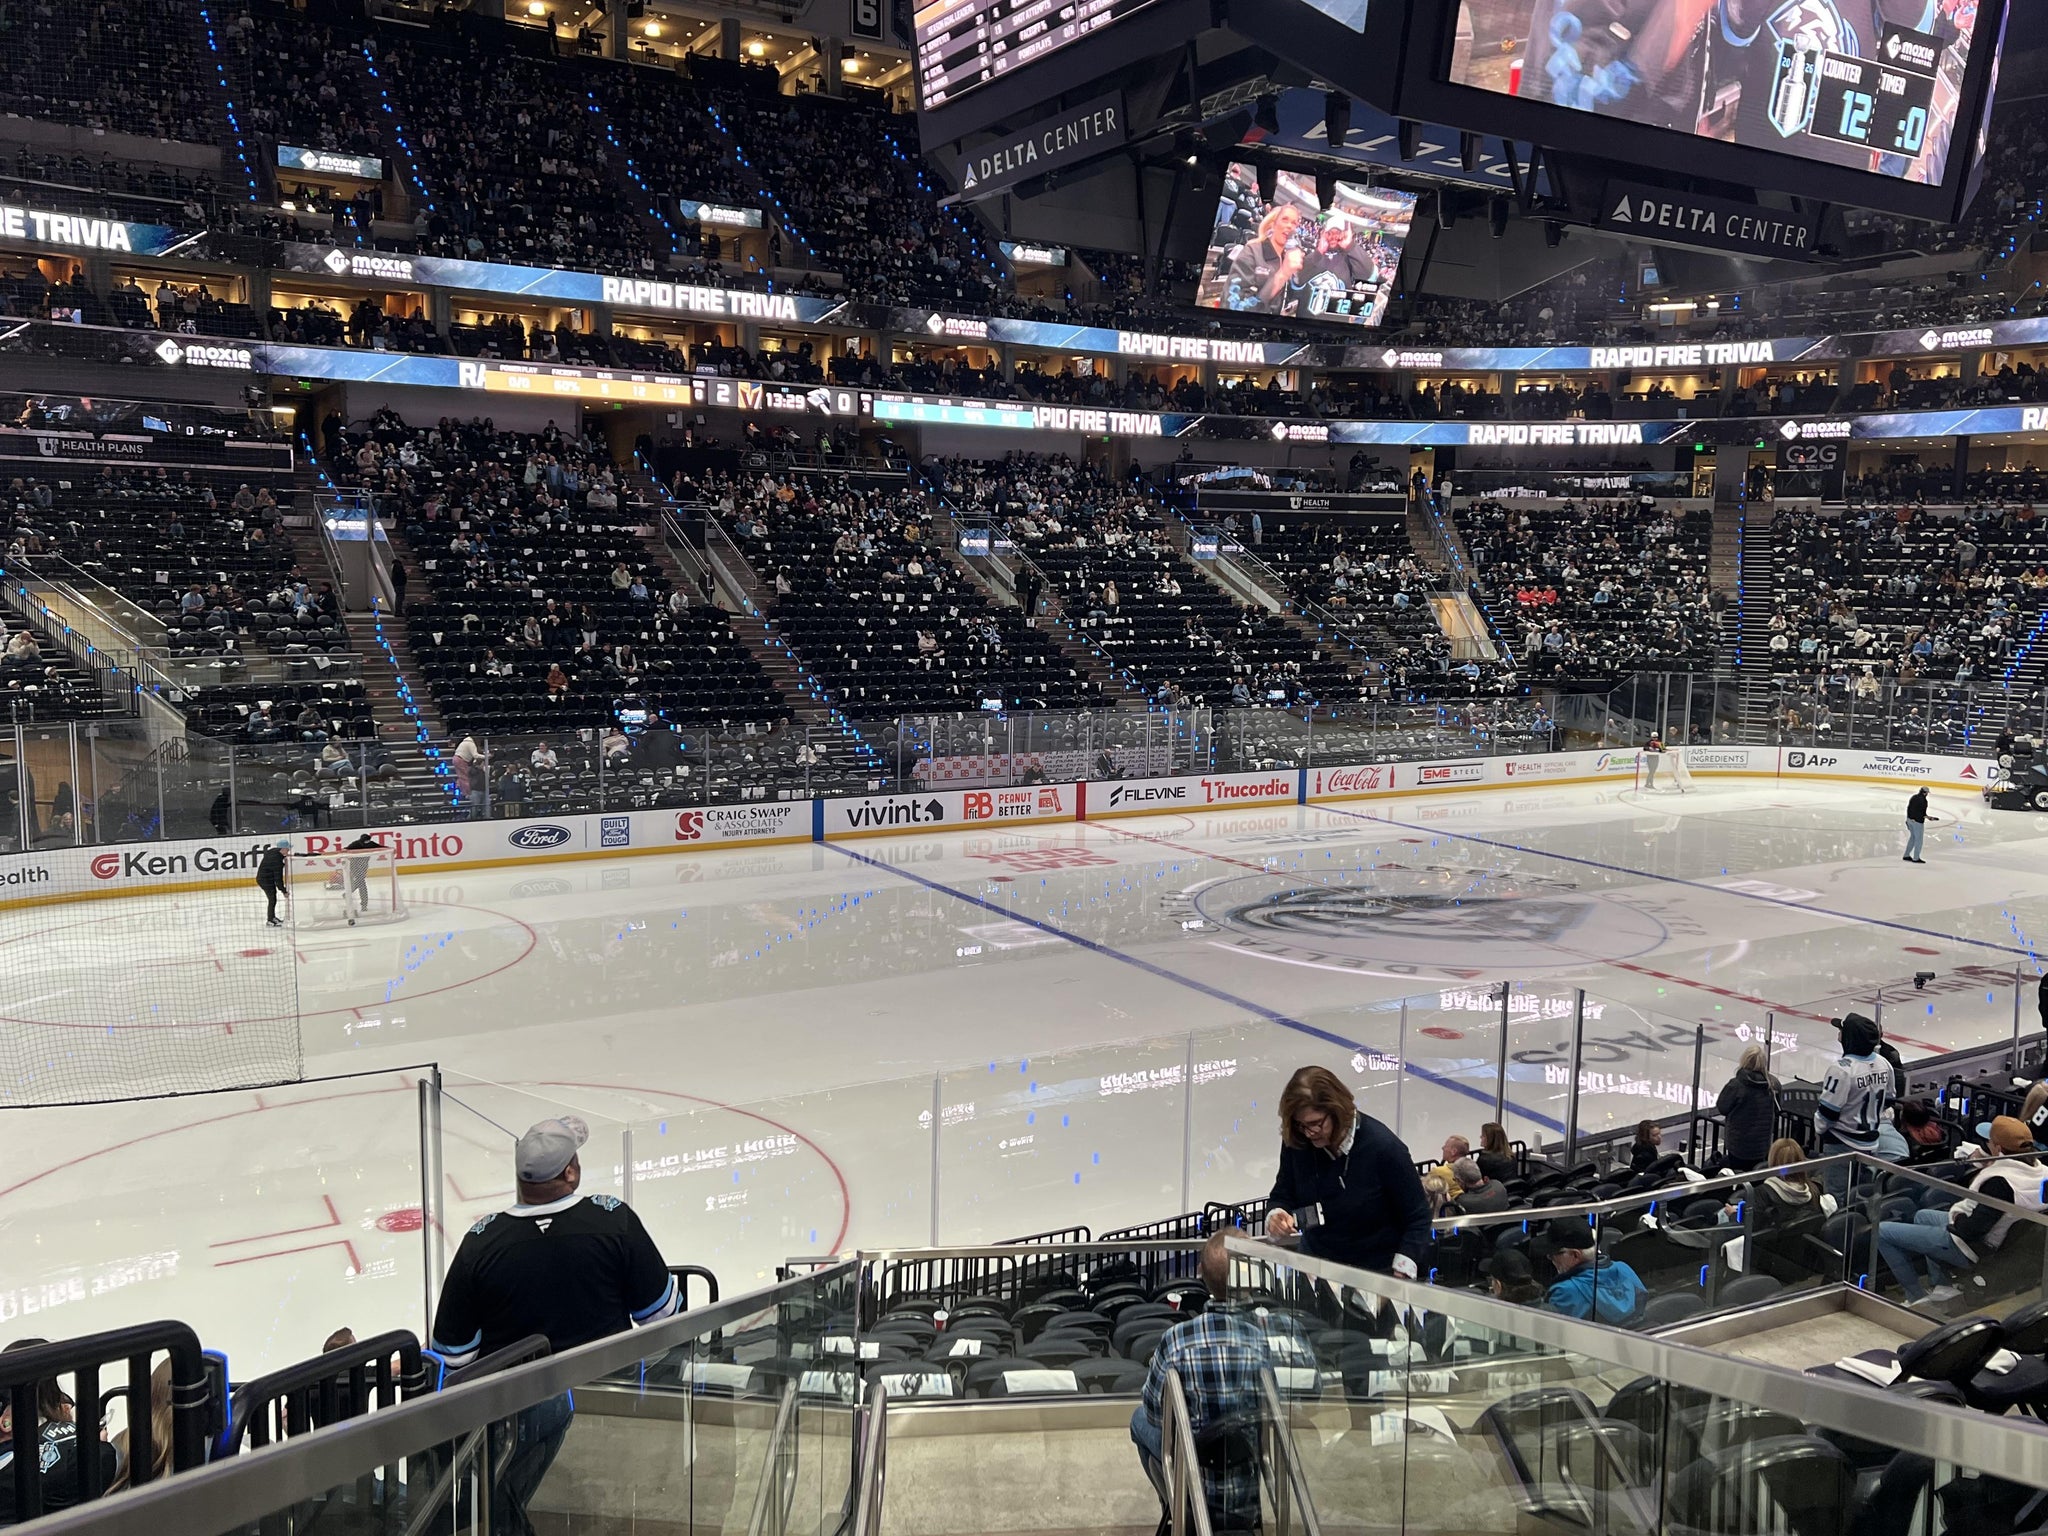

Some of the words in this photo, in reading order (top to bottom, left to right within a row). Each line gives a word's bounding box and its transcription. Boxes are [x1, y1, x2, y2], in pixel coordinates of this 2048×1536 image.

[1902, 41, 1935, 60] moxie
[1823, 58, 1862, 84] COUNTER
[1881, 73, 1906, 95] TIMER
[1839, 90, 1872, 139] 12
[980, 141, 1037, 179] DELTA
[1043, 107, 1117, 155] CENTER
[319, 156, 360, 170] moxie
[711, 207, 745, 219] moxie
[0, 207, 26, 238] E
[28, 211, 132, 251] TRIVIA
[1639, 200, 1716, 234] DELTA
[1725, 215, 1807, 249] CENTER
[352, 254, 412, 272] moxie
[374, 270, 412, 279] CONTROL
[603, 277, 673, 307] RAPID
[675, 285, 725, 312] FIRE
[727, 291, 797, 319] TRIVIA
[1336, 299, 1351, 314] 12
[945, 317, 988, 332] moxie
[1942, 328, 1993, 343] moxie
[186, 345, 251, 362] moxie
[1118, 332, 1169, 356] RAPID
[1171, 335, 1208, 360] FIRE
[1210, 340, 1264, 363] TRIVIA
[1591, 347, 1654, 368] RAPID
[1655, 345, 1702, 366] FIRE
[1705, 341, 1774, 365] TRIVIA
[209, 360, 251, 369] CONTROL
[1400, 352, 1443, 362] moxie
[716, 383, 730, 403] 2
[765, 392, 805, 409] 13:29
[838, 393, 850, 412] 0
[862, 401, 870, 413] 3
[1069, 410, 1105, 431] FIRE
[1108, 413, 1162, 435] TRIVIA
[1288, 424, 1328, 436] moxie
[1801, 421, 1851, 433] moxie
[1468, 425, 1529, 444] RAPID
[1530, 424, 1575, 444] FIRE
[1578, 424, 1643, 444] TRIVIA
[61, 440, 105, 452] HEALTH
[108, 443, 144, 454] PLANS
[1303, 499, 1330, 507] HEALTH
[1517, 762, 1542, 772] HEALTH
[1690, 755, 1745, 764] INGREDIENTS
[1807, 755, 1837, 768] APP
[1423, 768, 1451, 780] SME
[1453, 767, 1481, 776] STEEL
[1863, 763, 1903, 773] AMERICA
[1905, 766, 1932, 774] FIRST
[1124, 786, 1186, 801] FILEVINE
[1214, 778, 1290, 798] Trucordia
[998, 791, 1032, 804] PEANUT
[963, 792, 993, 819] PB
[998, 805, 1032, 817] BETTER
[706, 809, 747, 822] CRAIG
[749, 807, 791, 819] SWAPP
[847, 799, 921, 828] vivint
[968, 807, 978, 820] fit
[604, 820, 627, 830] BUILT
[714, 821, 723, 831] &
[723, 818, 784, 830] ASSOCIATES
[520, 827, 559, 847] Ford
[604, 836, 627, 845] TOUGH
[722, 829, 743, 838] INJURY
[743, 828, 776, 837] ATTORNEYS
[966, 847, 1093, 864] GEEK
[124, 850, 188, 877] Ken
[1008, 856, 1118, 873] SEAT
[1824, 1075, 1839, 1094] 11
[1856, 1088, 1885, 1132] 11
[46, 1424, 76, 1438] UTAH
